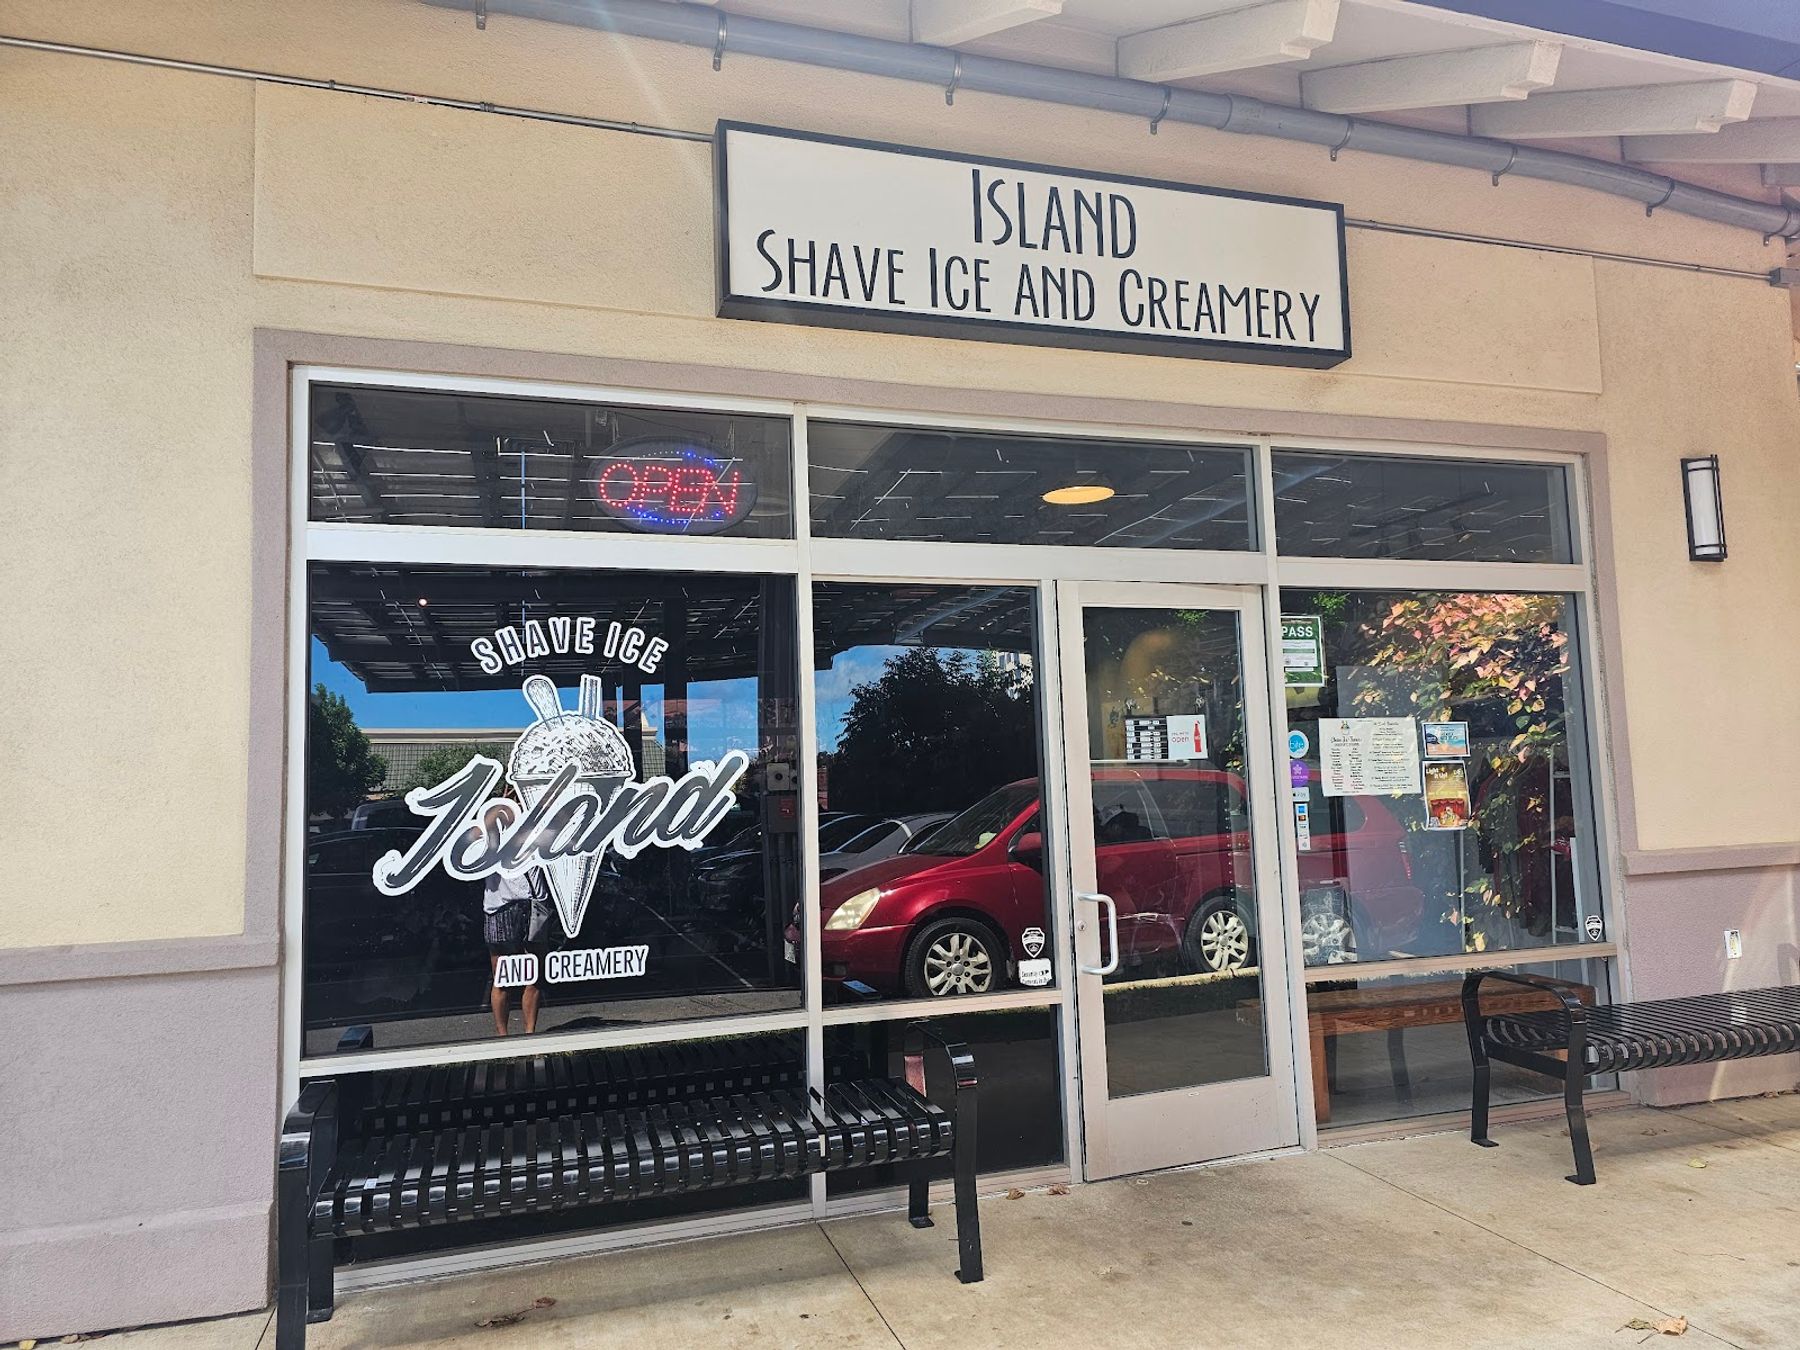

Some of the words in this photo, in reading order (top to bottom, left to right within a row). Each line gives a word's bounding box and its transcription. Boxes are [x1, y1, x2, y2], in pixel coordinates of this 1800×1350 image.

[972, 168, 1137, 260] ISLAND
[756, 229, 905, 305] SHAVE
[929, 247, 991, 313] ICE
[1014, 263, 1096, 322] AND
[1119, 268, 1321, 342] CREAMERY
[599, 462, 740, 516] OPEN
[472, 617, 596, 673] SHAVE
[604, 622, 669, 673] ICE
[1282, 626, 1314, 638] PASS
[375, 751, 748, 894] Island
[496, 956, 537, 986] AND
[547, 947, 647, 981] CREAMERY
